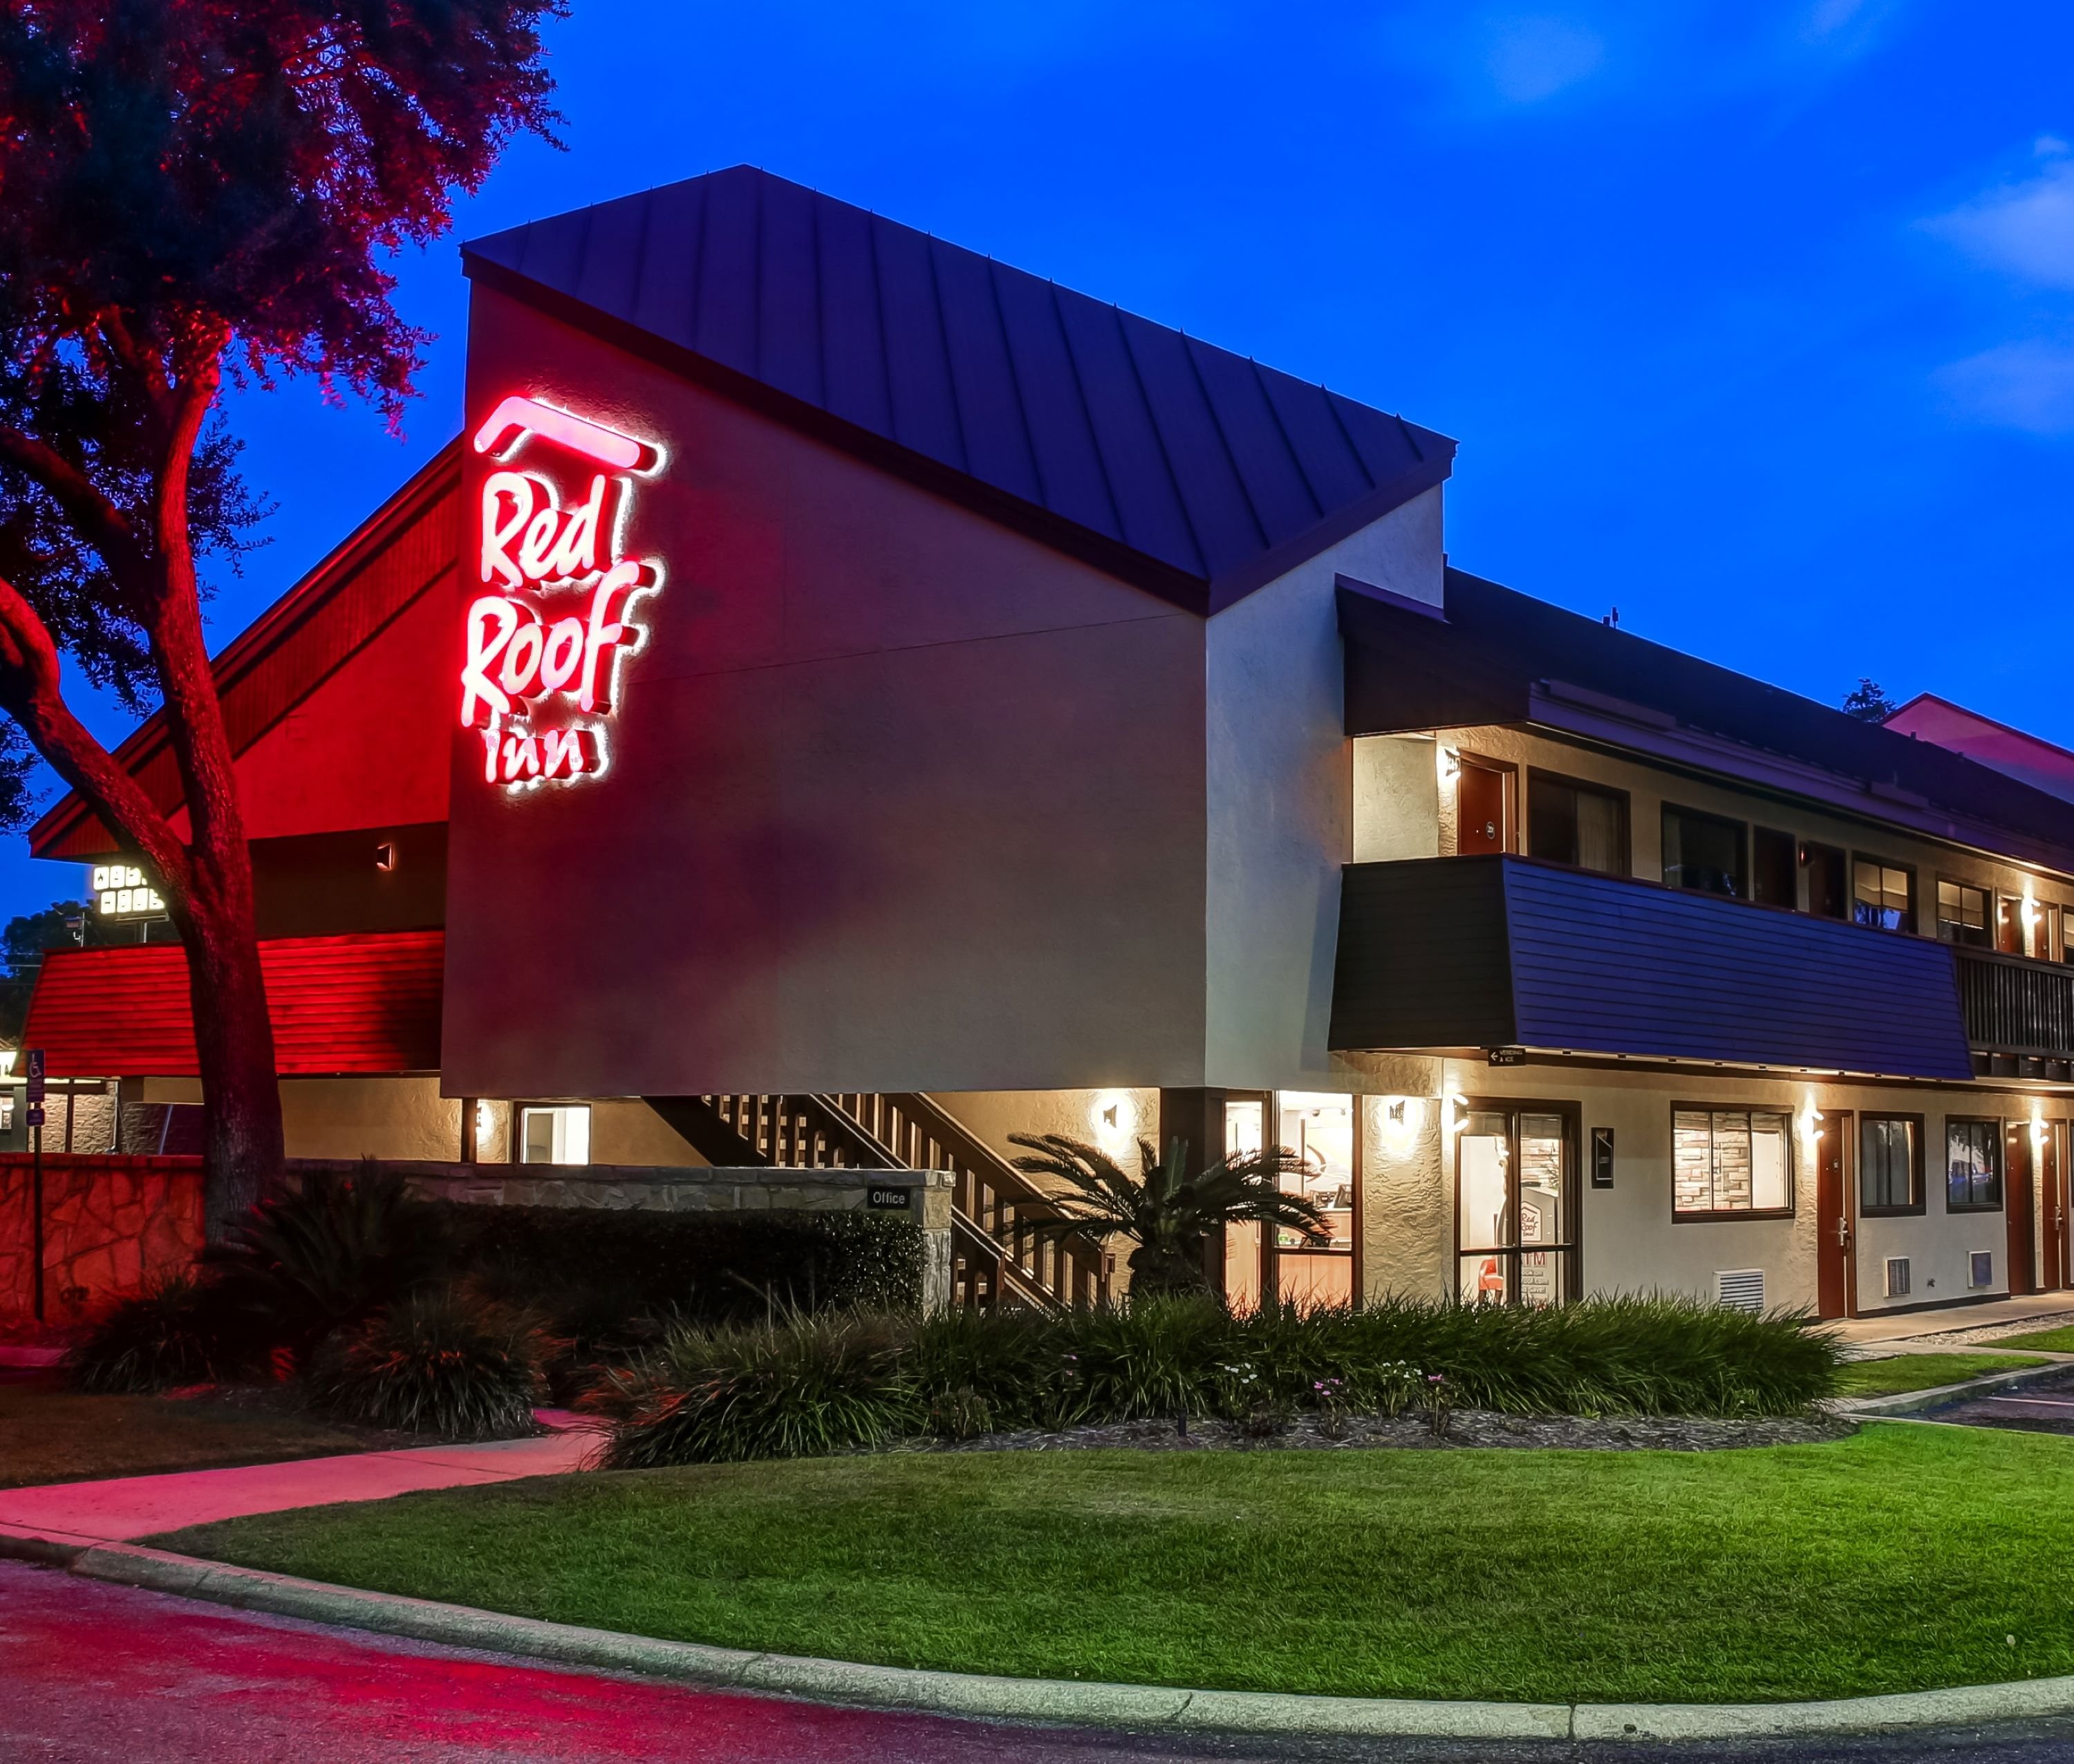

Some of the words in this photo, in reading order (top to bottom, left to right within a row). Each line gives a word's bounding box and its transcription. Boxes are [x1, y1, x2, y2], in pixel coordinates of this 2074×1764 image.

[480, 471, 607, 588] Red
[461, 561, 639, 727] Roof
[485, 729, 583, 784] Inn
[873, 1192, 905, 1204] Office
[1524, 1252, 1545, 1265] TM
